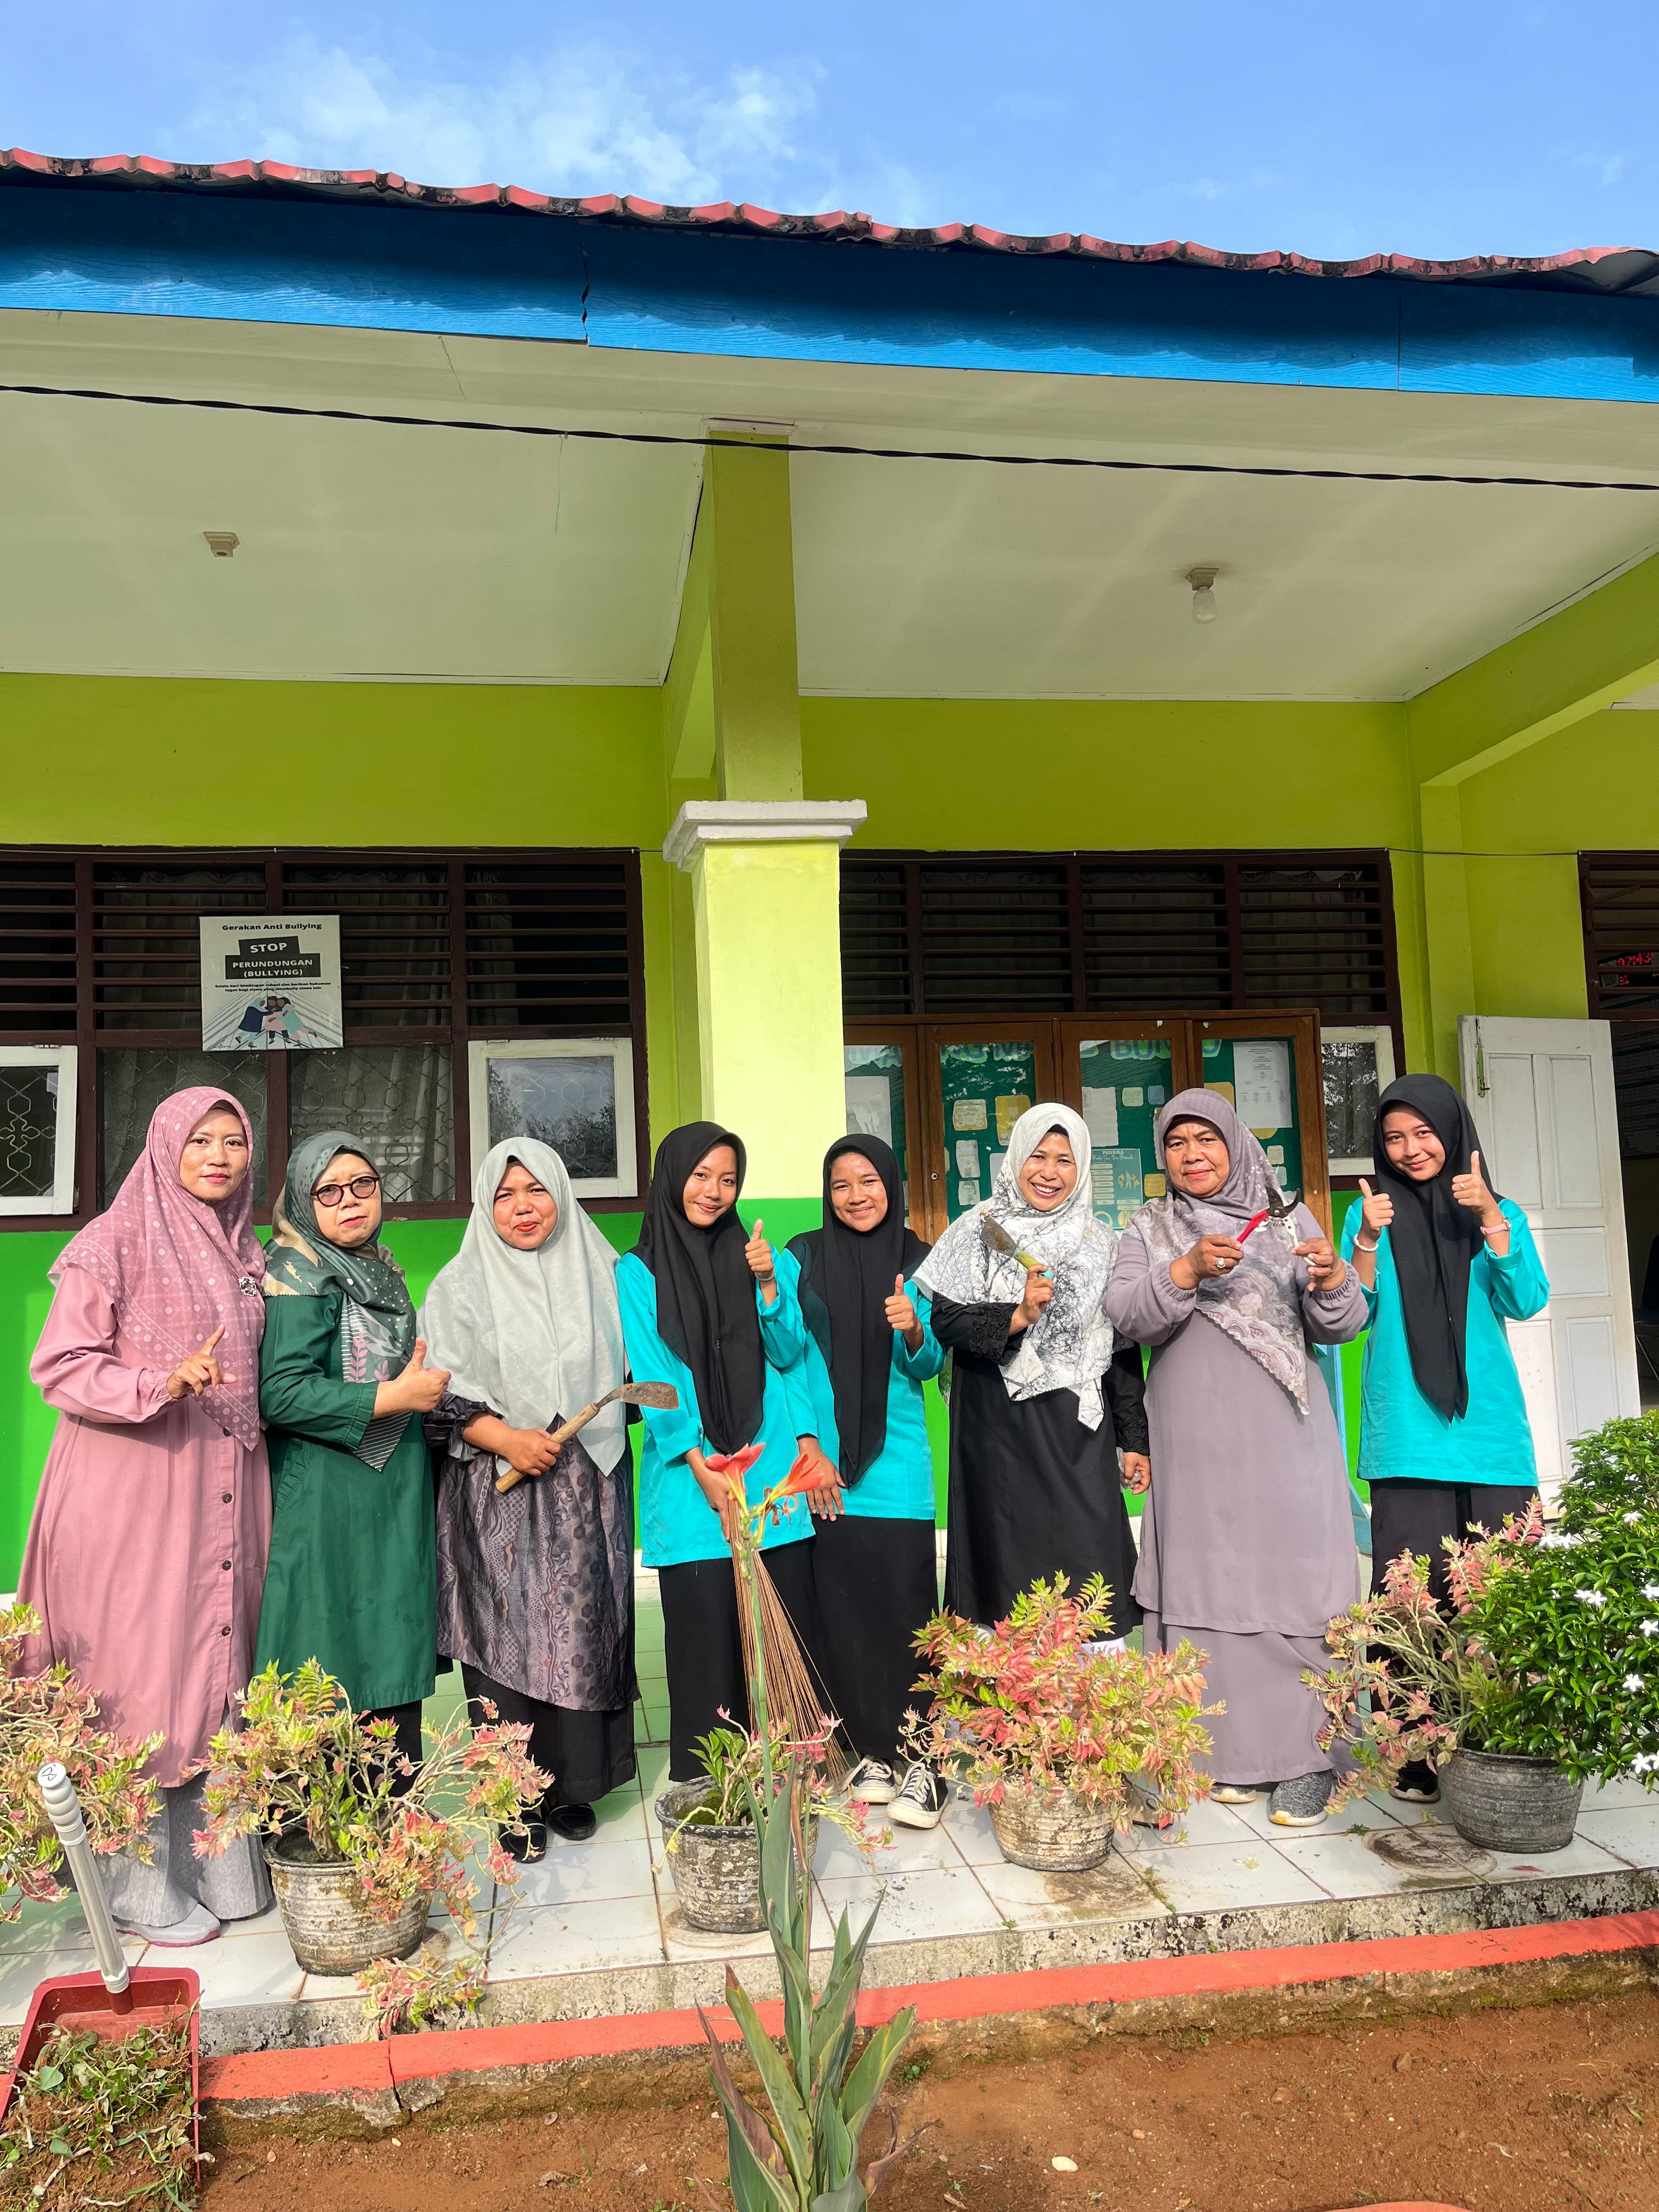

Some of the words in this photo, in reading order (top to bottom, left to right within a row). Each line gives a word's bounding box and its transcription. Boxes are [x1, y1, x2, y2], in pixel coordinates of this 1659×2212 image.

[250, 942, 288, 953] STOP
[233, 959, 313, 968] PERUNDUNGAN
[244, 969, 303, 978] (BULLYING)
